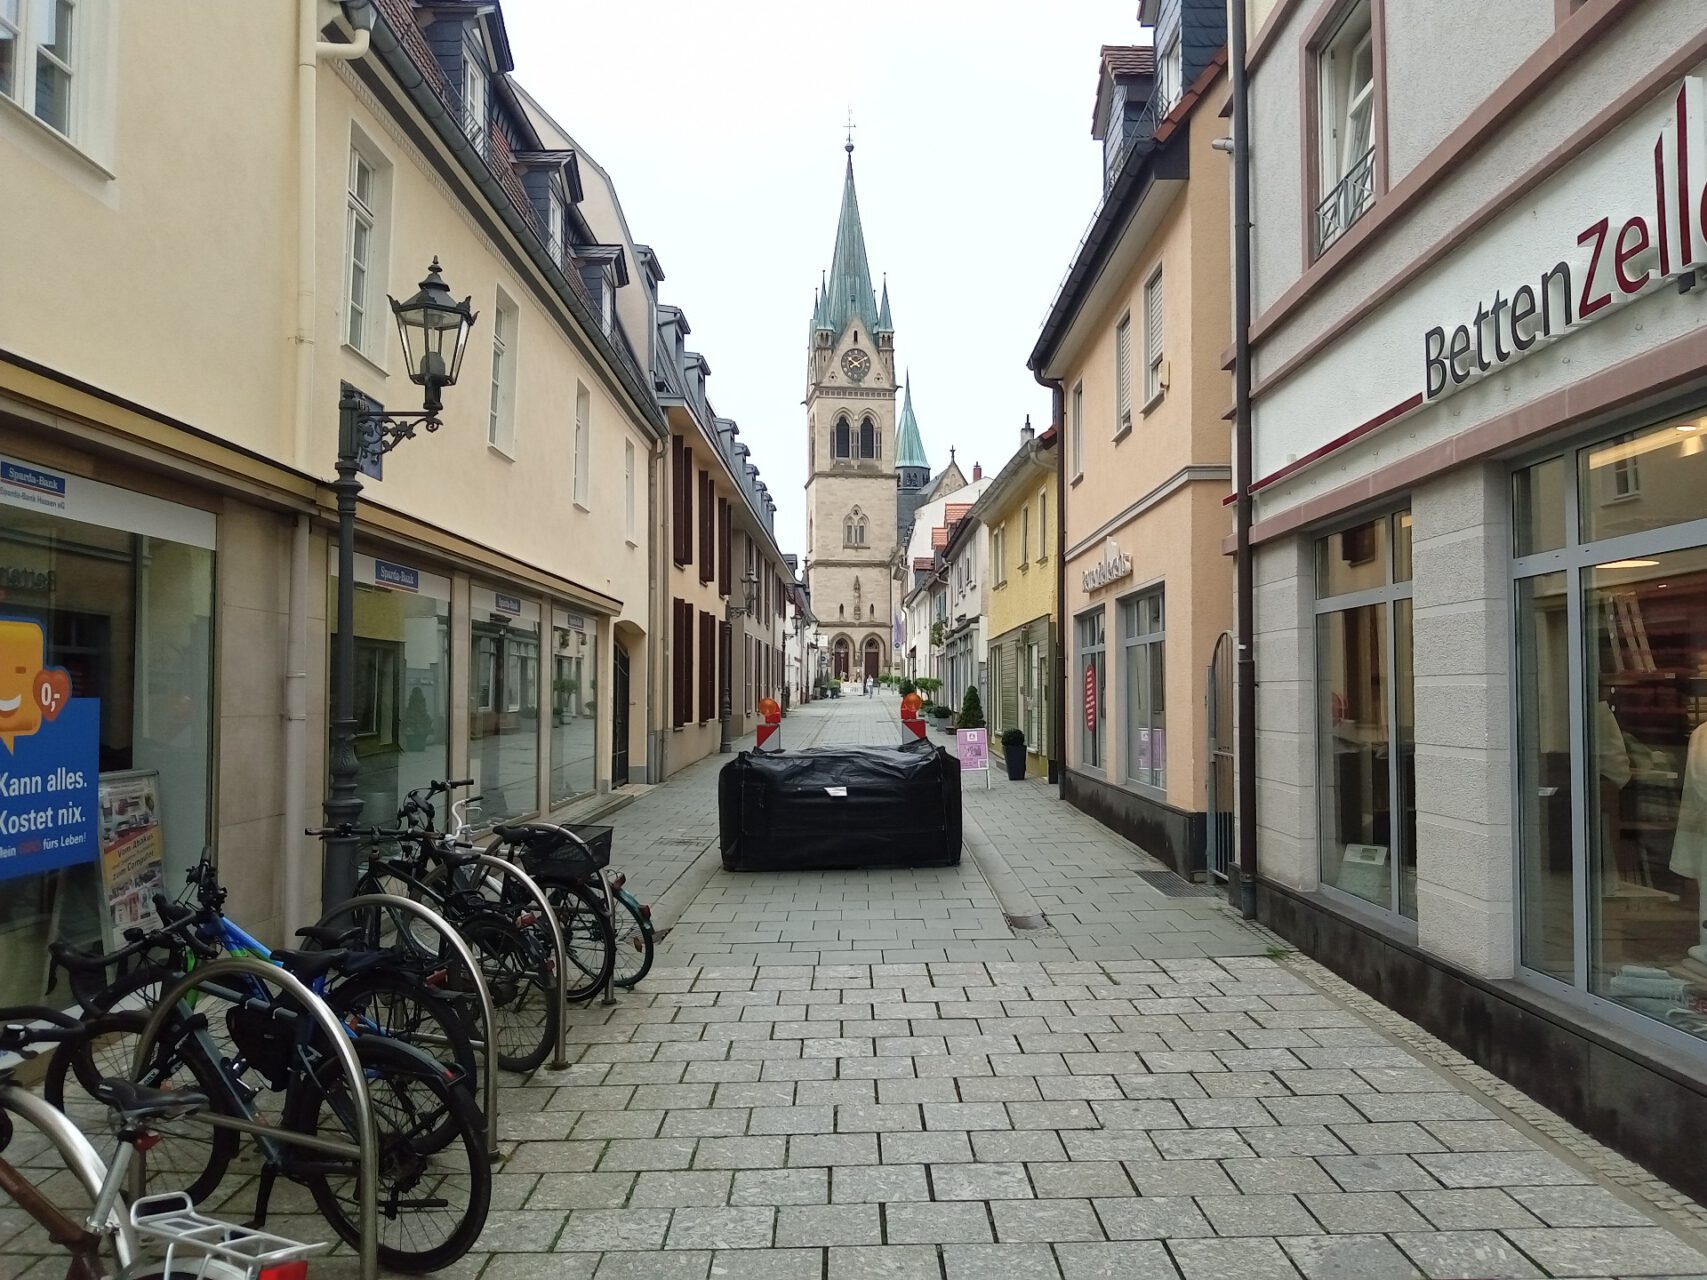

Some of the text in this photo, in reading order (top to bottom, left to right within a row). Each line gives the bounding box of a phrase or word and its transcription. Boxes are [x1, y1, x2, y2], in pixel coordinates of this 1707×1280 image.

[1424, 80, 1707, 400] Bettenzell
[9, 467, 58, 490] Sparda-Bank
[381, 565, 414, 585] Sparda-Bank
[47, 767, 88, 792] alles.
[58, 802, 86, 827] nix.
[43, 838, 59, 851] fürs
[60, 832, 87, 847] Leben!
[117, 845, 132, 858] Vom
